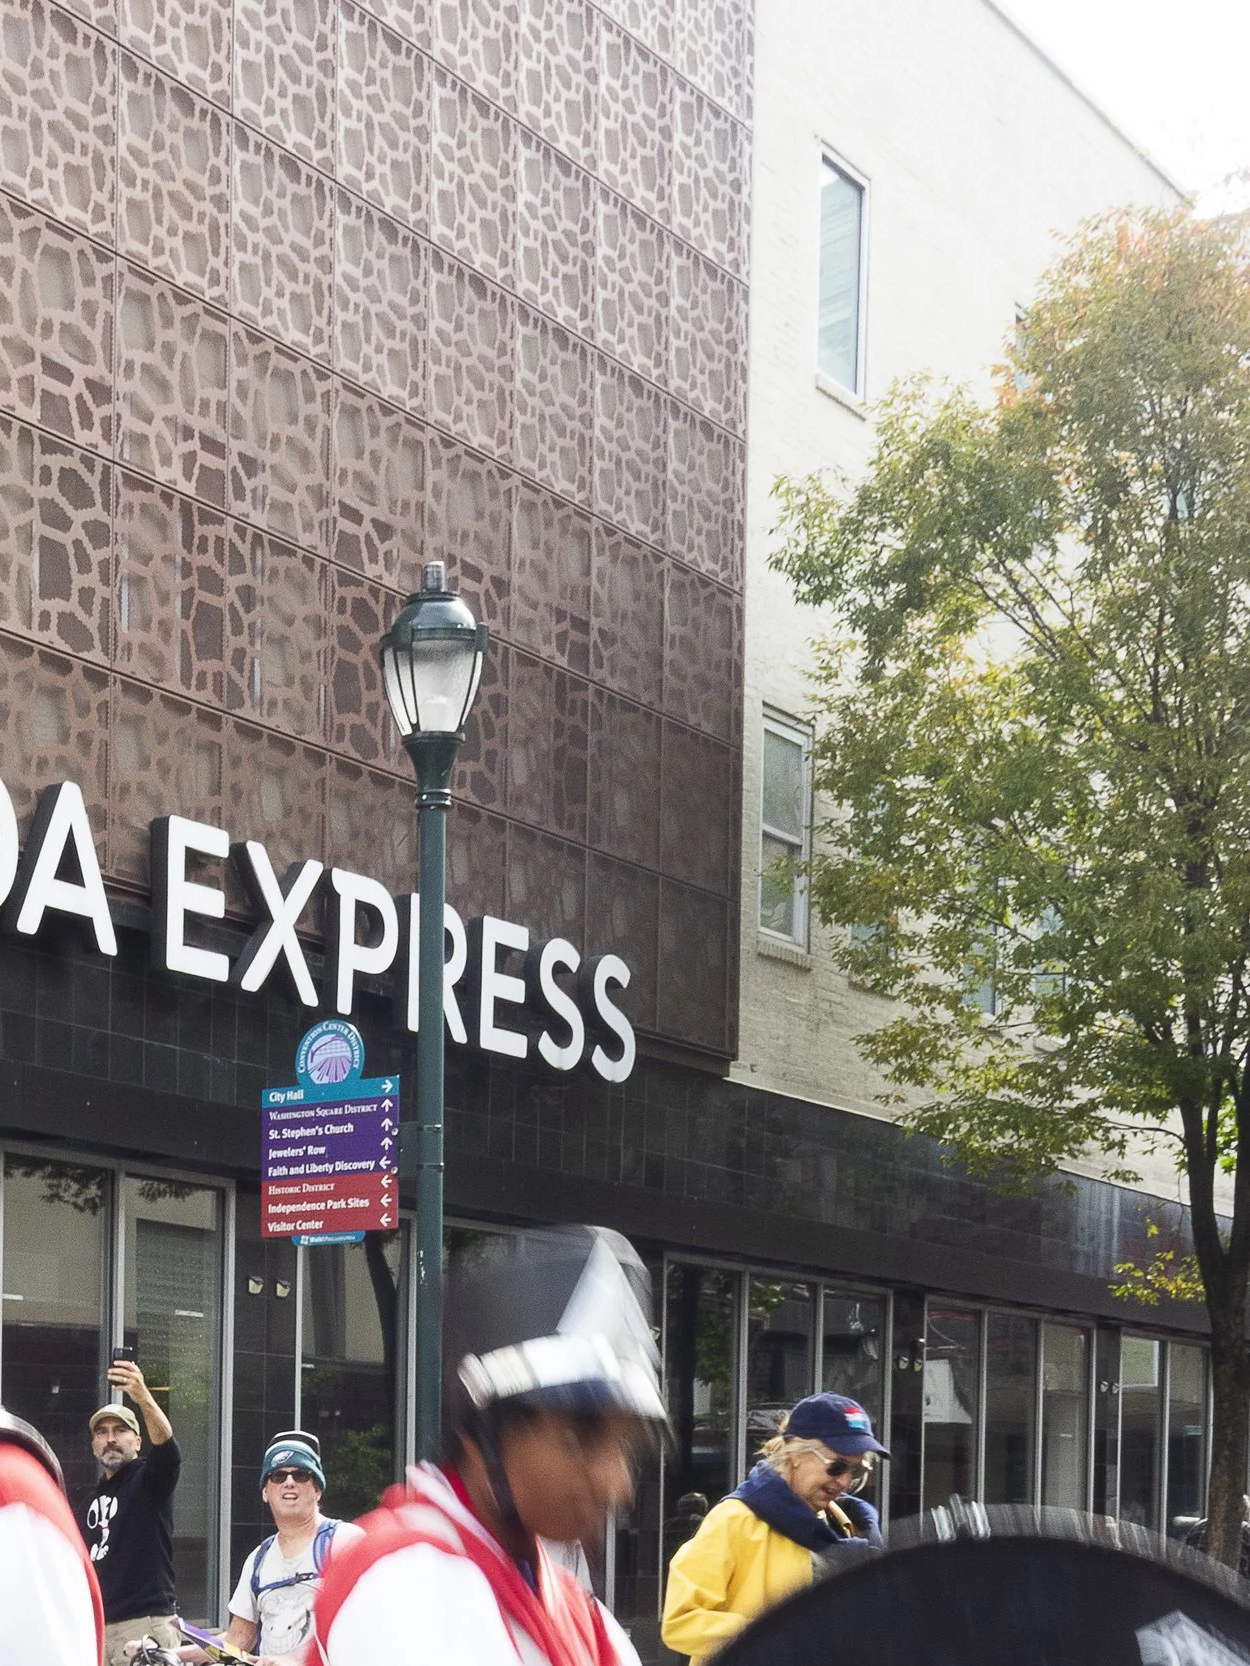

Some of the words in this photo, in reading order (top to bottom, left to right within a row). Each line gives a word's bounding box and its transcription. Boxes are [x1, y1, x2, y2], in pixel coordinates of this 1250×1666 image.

[166, 814, 636, 1084] EXPRESS
[298, 1026, 323, 1073] CONVENTION
[322, 1021, 350, 1036] CENTER
[347, 1031, 360, 1069] DISTRICT
[269, 1092, 286, 1104] City
[286, 1089, 304, 1101] Hall
[269, 1110, 315, 1121] WASHINGTON
[315, 1107, 343, 1118] SQUARE
[344, 1104, 378, 1114] DISTRICT
[268, 1129, 281, 1140] St.
[281, 1125, 324, 1140] Stephen's
[324, 1122, 354, 1135] Church
[268, 1146, 307, 1160] Jewelers'
[307, 1145, 326, 1156] Row
[268, 1165, 288, 1177] Faith
[289, 1164, 305, 1175] and
[306, 1161, 335, 1174] Liberty
[335, 1160, 376, 1171] Discovery
[268, 1185, 302, 1196] HISTORIC
[302, 1182, 335, 1192] DISTRICT
[268, 1201, 326, 1215] Independence
[326, 1199, 347, 1210] Park
[347, 1197, 370, 1208] Sites
[268, 1221, 295, 1233] Visitor
[295, 1219, 324, 1231] Center
